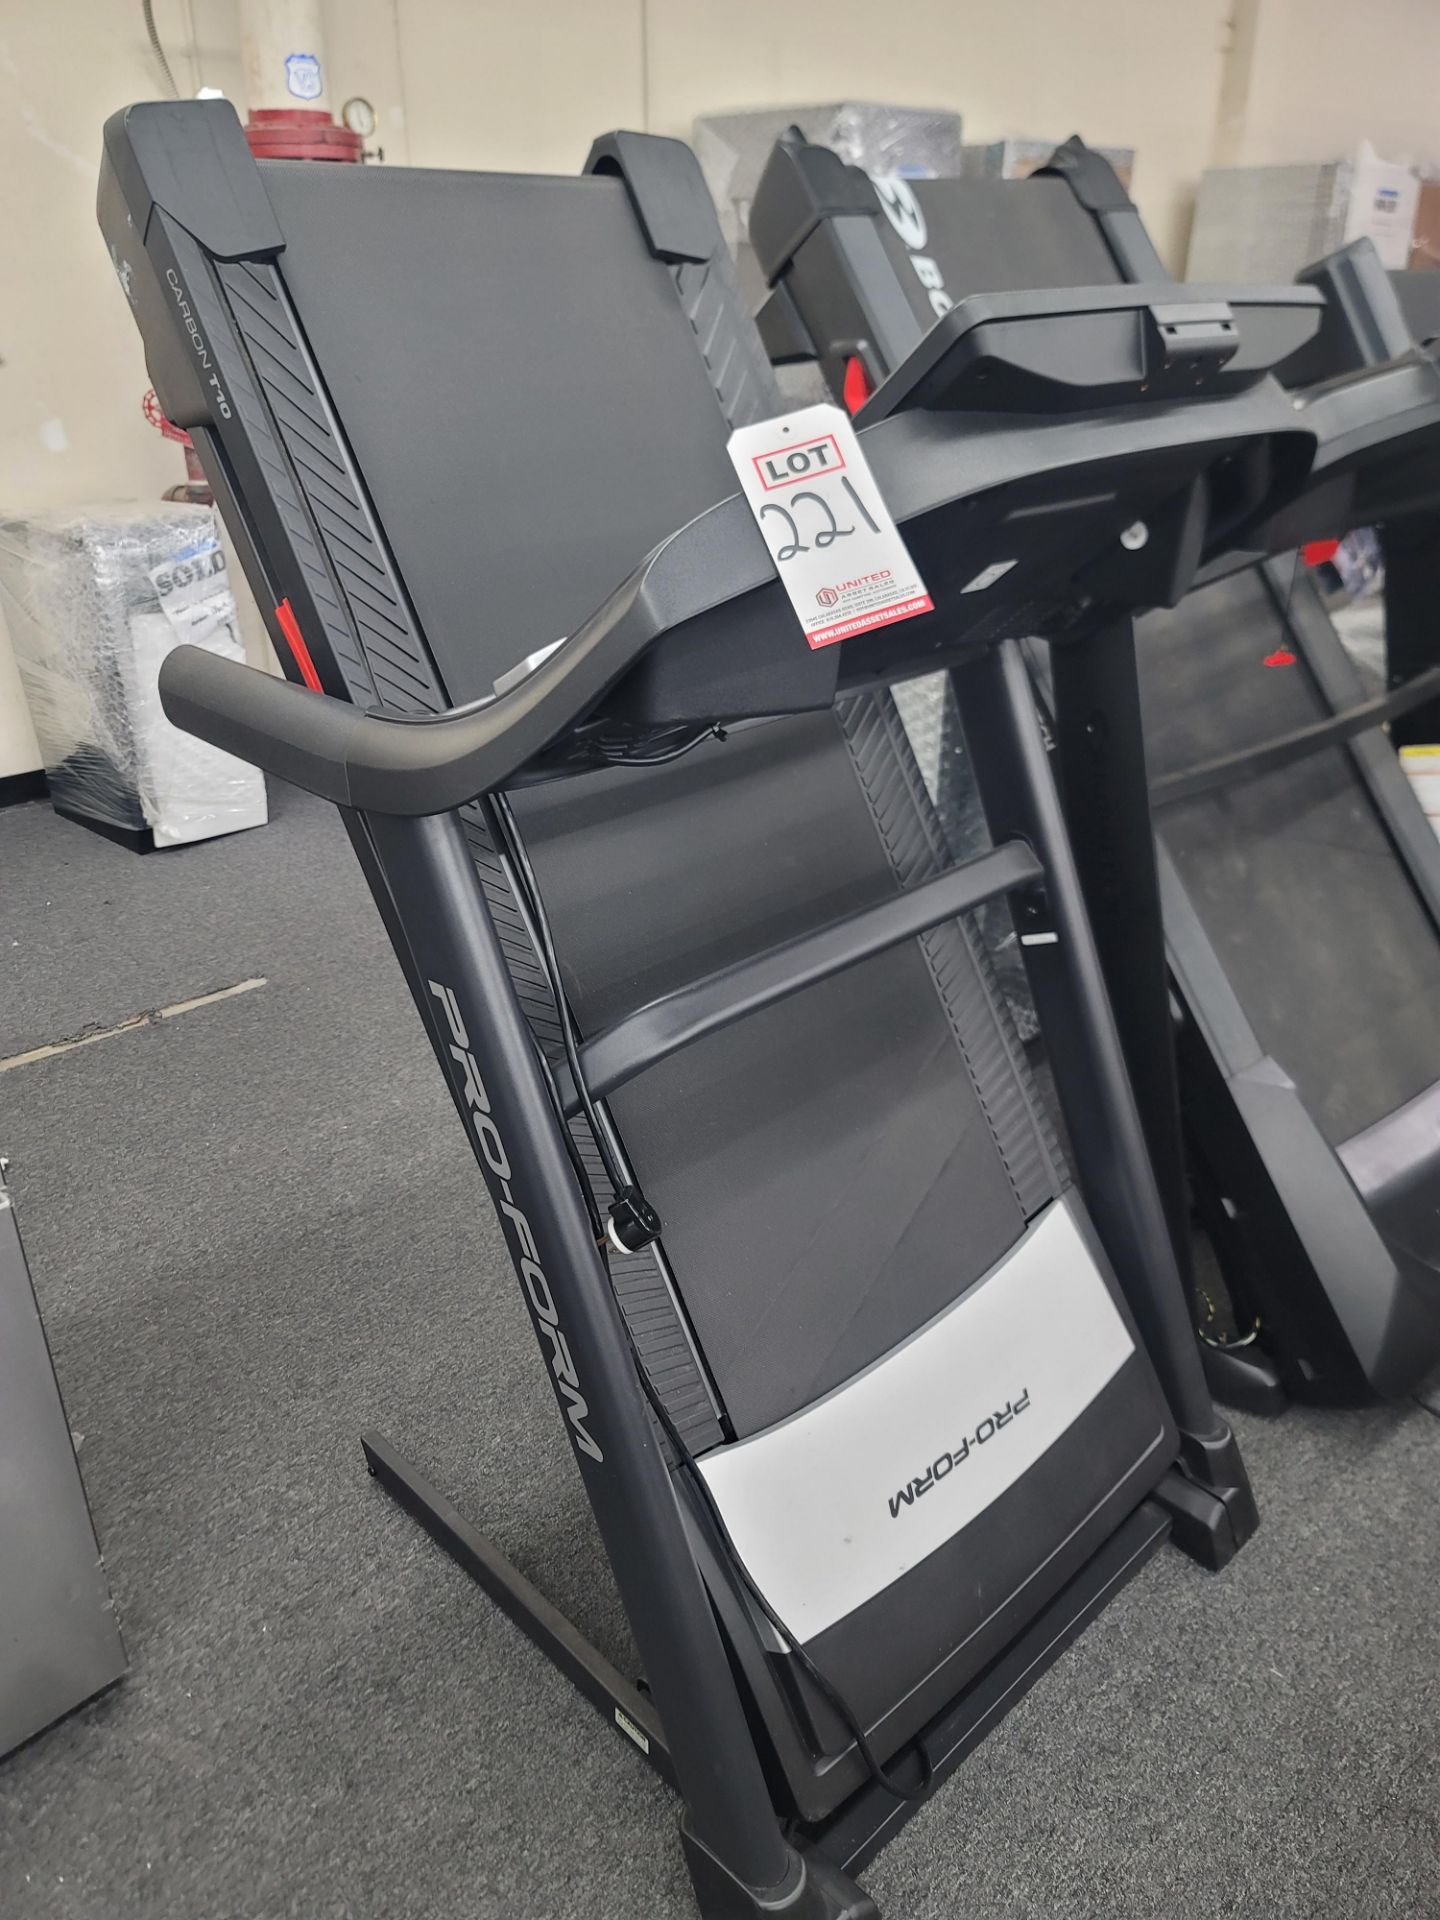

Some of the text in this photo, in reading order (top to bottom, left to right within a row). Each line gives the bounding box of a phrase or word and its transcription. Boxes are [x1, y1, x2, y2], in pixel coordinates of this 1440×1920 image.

[166, 268, 232, 419] CARBON T10
[765, 443, 829, 482] LOT
[759, 475, 881, 562] 221
[836, 570, 891, 591] UNITED
[841, 587, 867, 600] ASSET
[868, 579, 895, 592] SALES
[812, 600, 926, 642] WWW.UNITEDASSETSALES.COM
[428, 979, 604, 1465] PRO-FORM
[888, 1387, 1031, 1519] PRO-FORM
